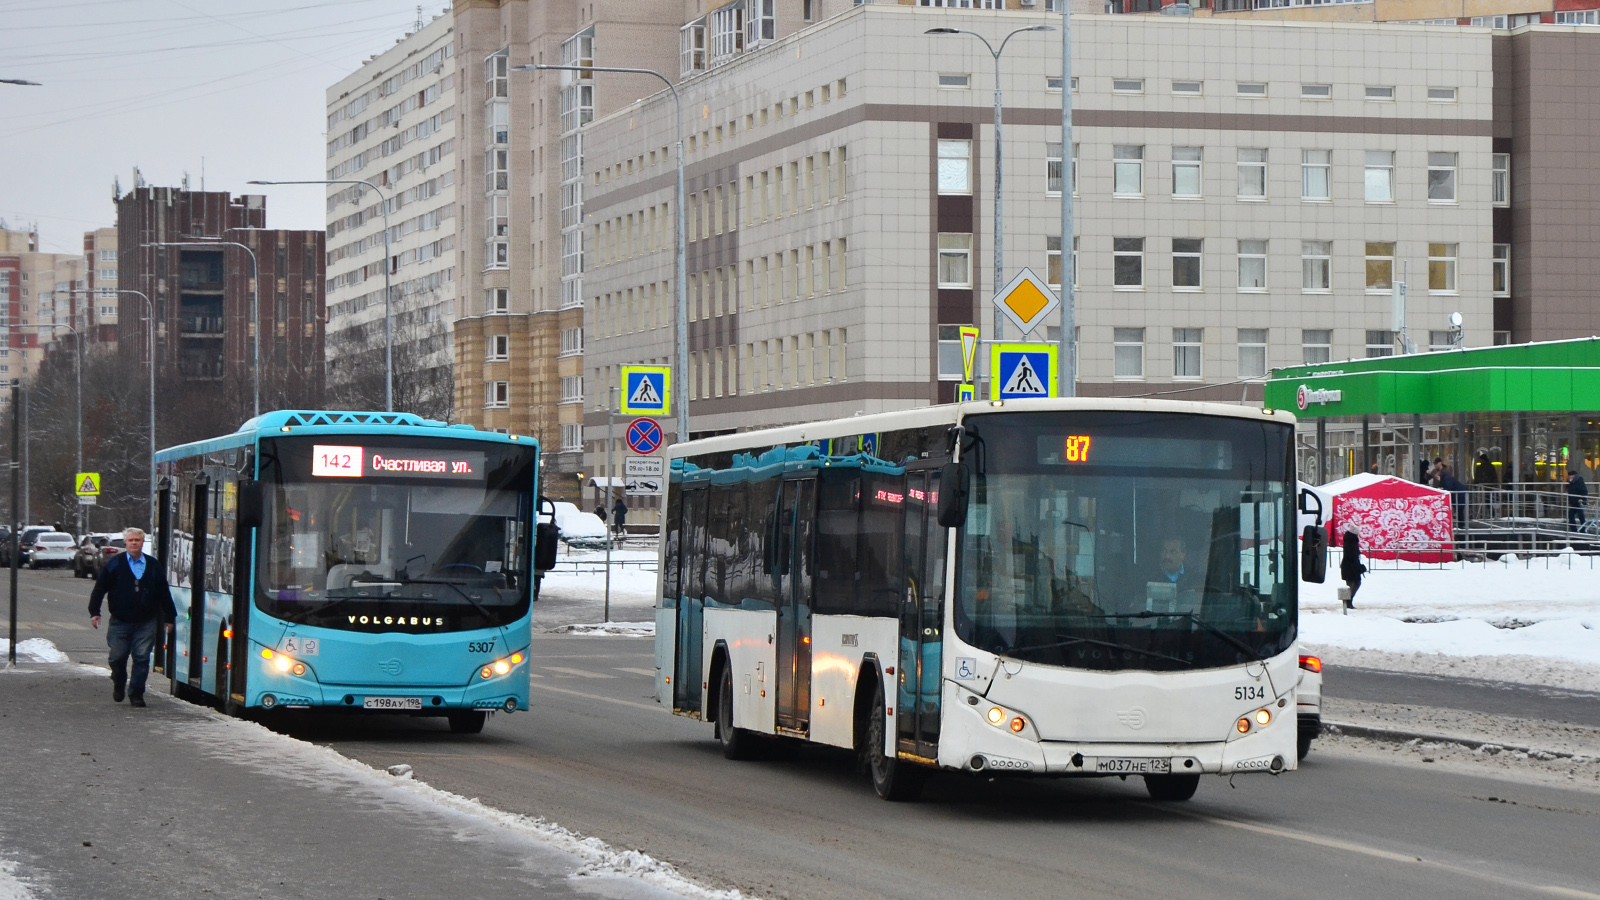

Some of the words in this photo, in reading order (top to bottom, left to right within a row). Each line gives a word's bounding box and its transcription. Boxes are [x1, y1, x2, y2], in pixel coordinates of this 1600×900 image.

[1066, 435, 1090, 462] 87
[321, 454, 351, 468] 142
[372, 454, 447, 472] Счастливая
[451, 461, 472, 473] ул.
[348, 615, 443, 626] VOLGABUS
[468, 641, 495, 653] 5307
[1234, 686, 1265, 700] 5134
[366, 698, 404, 708] С198АУ
[406, 698, 420, 706] 198
[1100, 759, 1147, 772] М037НЕ
[1149, 759, 1169, 769] 123
